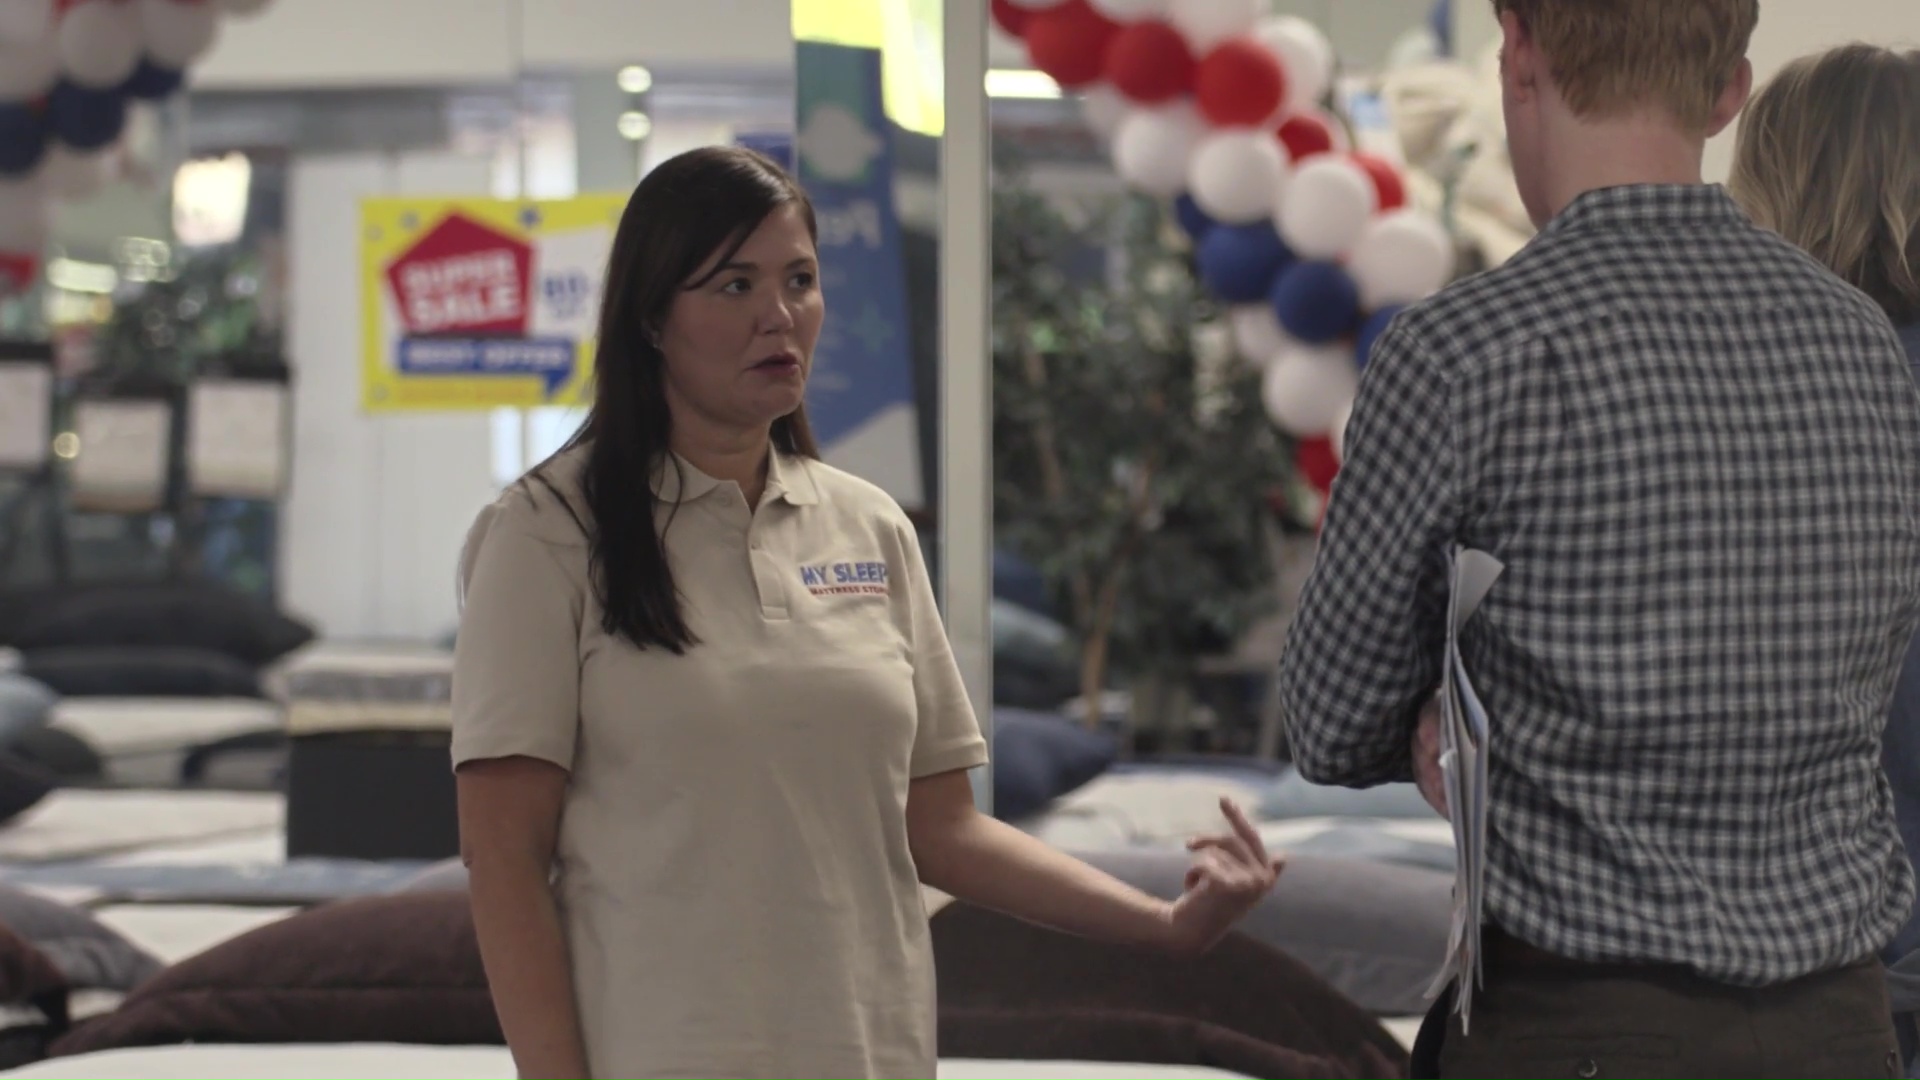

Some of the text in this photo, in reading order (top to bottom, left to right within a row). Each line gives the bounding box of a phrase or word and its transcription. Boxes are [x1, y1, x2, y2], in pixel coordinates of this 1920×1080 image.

[401, 250, 518, 292] SUPER
[409, 282, 523, 331] SALE
[405, 343, 572, 370] BEST OFFER
[800, 562, 888, 586] MY SLEEP
[809, 585, 860, 595] MATTRESS
